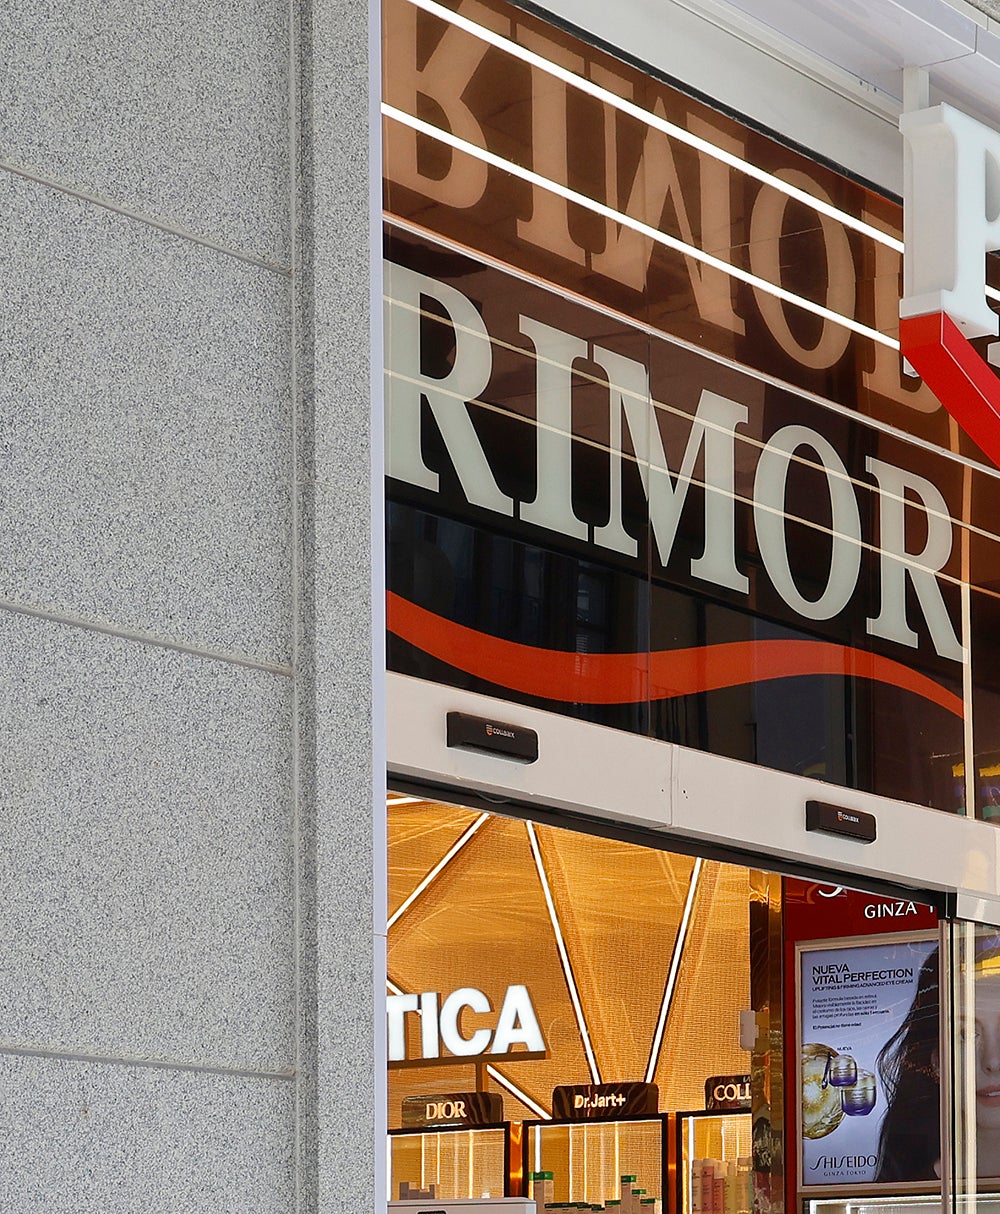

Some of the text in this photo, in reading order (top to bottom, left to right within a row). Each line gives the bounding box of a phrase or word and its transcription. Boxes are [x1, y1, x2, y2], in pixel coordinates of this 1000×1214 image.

[864, 902, 918, 918] GINZA
[812, 964, 850, 976] NUEVA
[812, 968, 914, 985] VITAL PERFECTION
[426, 1100, 468, 1120] DIOR
[574, 1094, 626, 1110] Dr.Jart+
[810, 1154, 878, 1170] SHISEIDO
